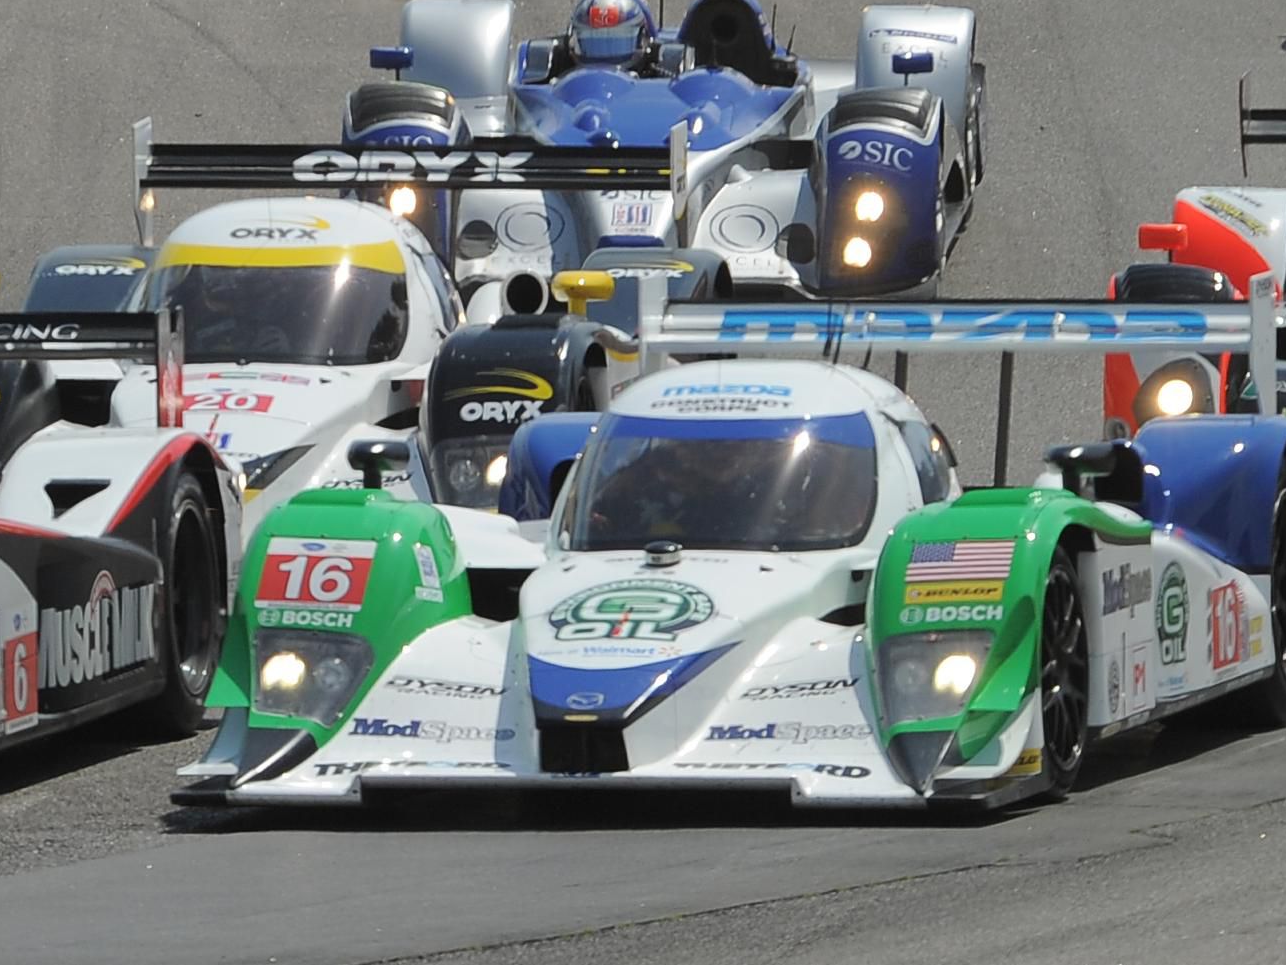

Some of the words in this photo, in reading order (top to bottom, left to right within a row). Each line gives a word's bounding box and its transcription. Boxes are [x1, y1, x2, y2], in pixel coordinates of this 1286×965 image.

[293, 151, 534, 182] ORYX
[864, 140, 913, 171] SIC
[230, 227, 318, 240] ORYX
[55, 264, 135, 276] ORYX
[193, 394, 258, 410] 20
[459, 400, 544, 423] ORYX
[278, 555, 354, 603] 16
[282, 610, 353, 627] BOSCH
[925, 604, 1003, 623] BOSCH
[555, 620, 678, 642] OIL
[1161, 638, 1187, 666] OIL
[13, 642, 30, 713] 6
[385, 677, 508, 696] DYSON
[740, 677, 860, 700] DYSON
[348, 717, 516, 744] ModSpace
[704, 721, 874, 745] ModSpace
